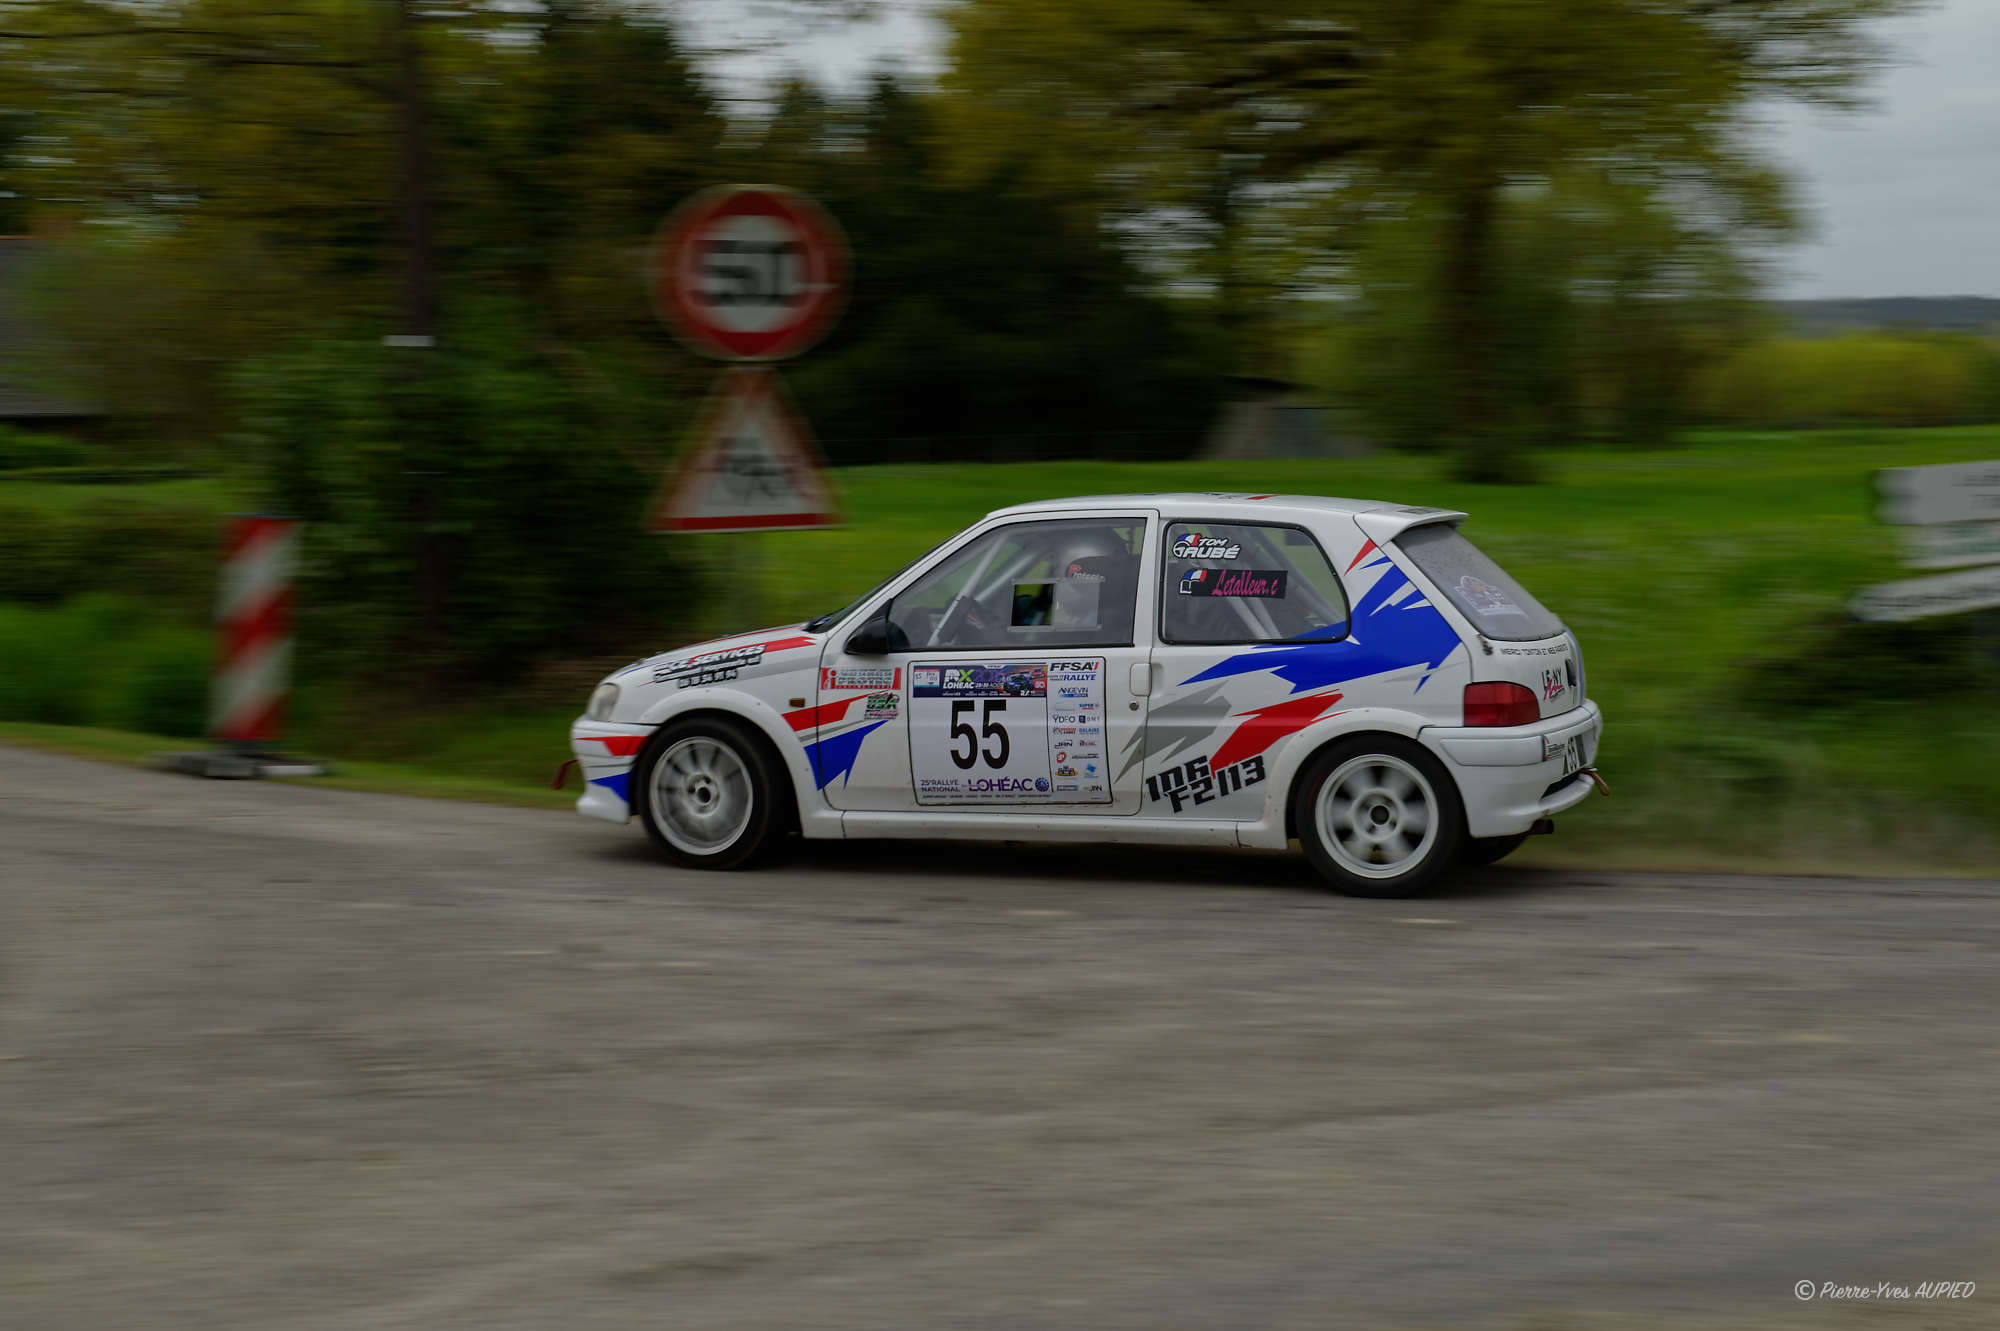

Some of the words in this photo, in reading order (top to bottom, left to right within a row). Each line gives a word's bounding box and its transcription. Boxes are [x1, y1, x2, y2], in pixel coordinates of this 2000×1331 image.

[1199, 538, 1228, 546] TOM
[1049, 662, 1093, 671] FFSA
[950, 699, 1010, 770] 55
[968, 776, 1034, 792] LOHÉAC
[1145, 755, 1209, 802] 106
